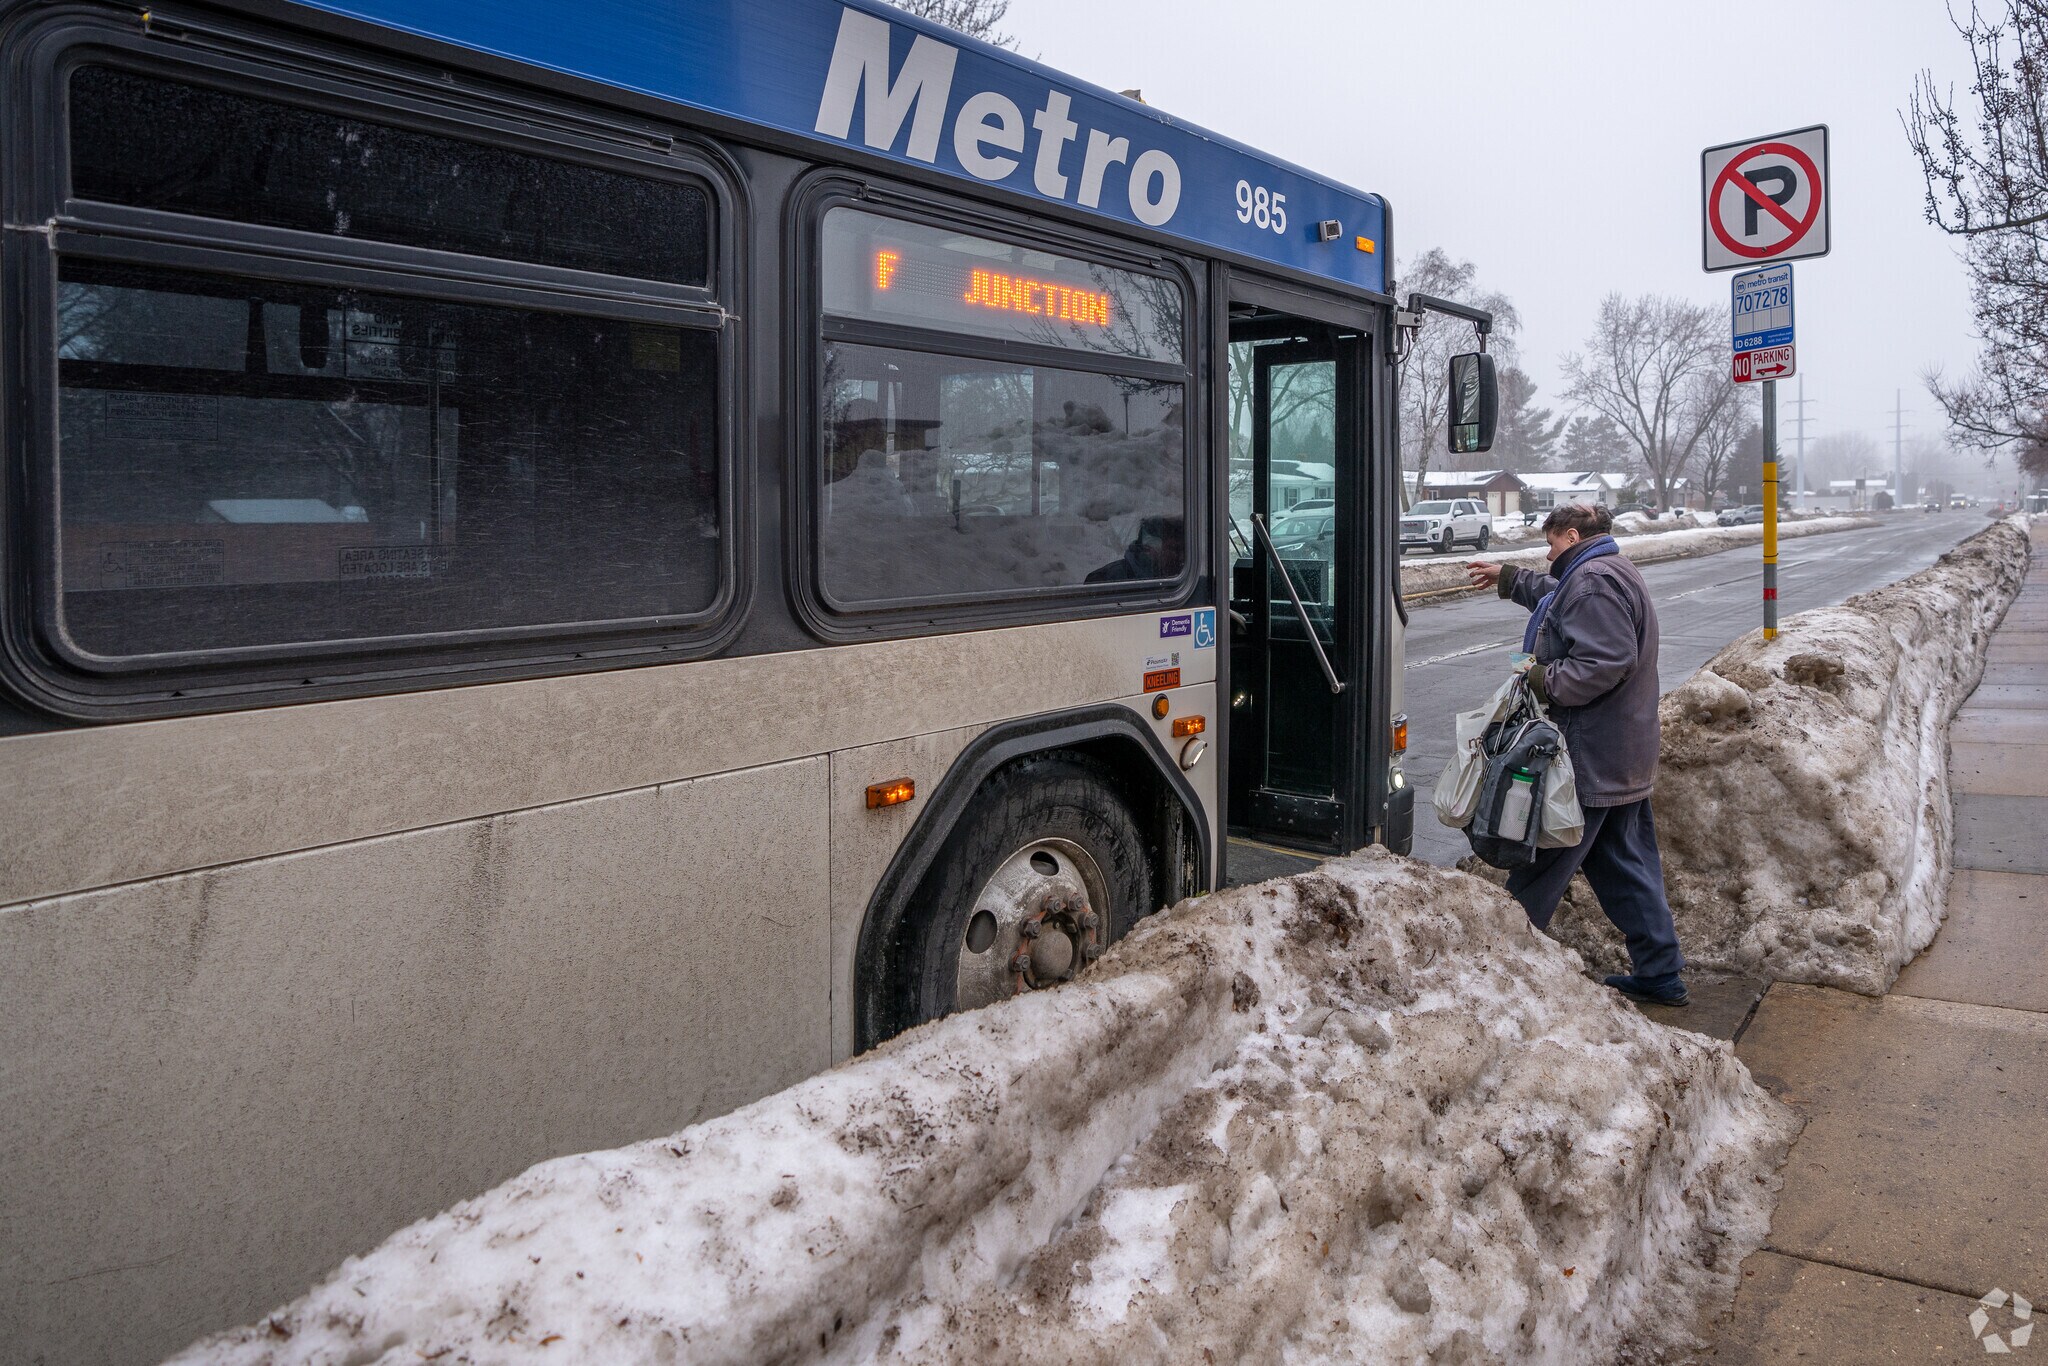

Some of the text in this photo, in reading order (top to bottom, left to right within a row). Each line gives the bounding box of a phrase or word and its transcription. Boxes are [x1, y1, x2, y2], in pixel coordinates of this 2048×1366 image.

[814, 7, 1182, 227] Metro
[1234, 179, 1288, 235] 985
[877, 251, 1108, 326] F JUNCTION
[1747, 277, 1767, 289] metro
[1768, 272, 1789, 284] transit
[1736, 286, 1788, 314] 70 72 78
[1735, 339, 1744, 349] ID
[1744, 336, 1763, 347] 6288
[1753, 348, 1790, 366] PARKING
[1735, 358, 1750, 378] NO
[1172, 625, 1187, 633] Friendly
[1147, 671, 1178, 688] KNEELING
